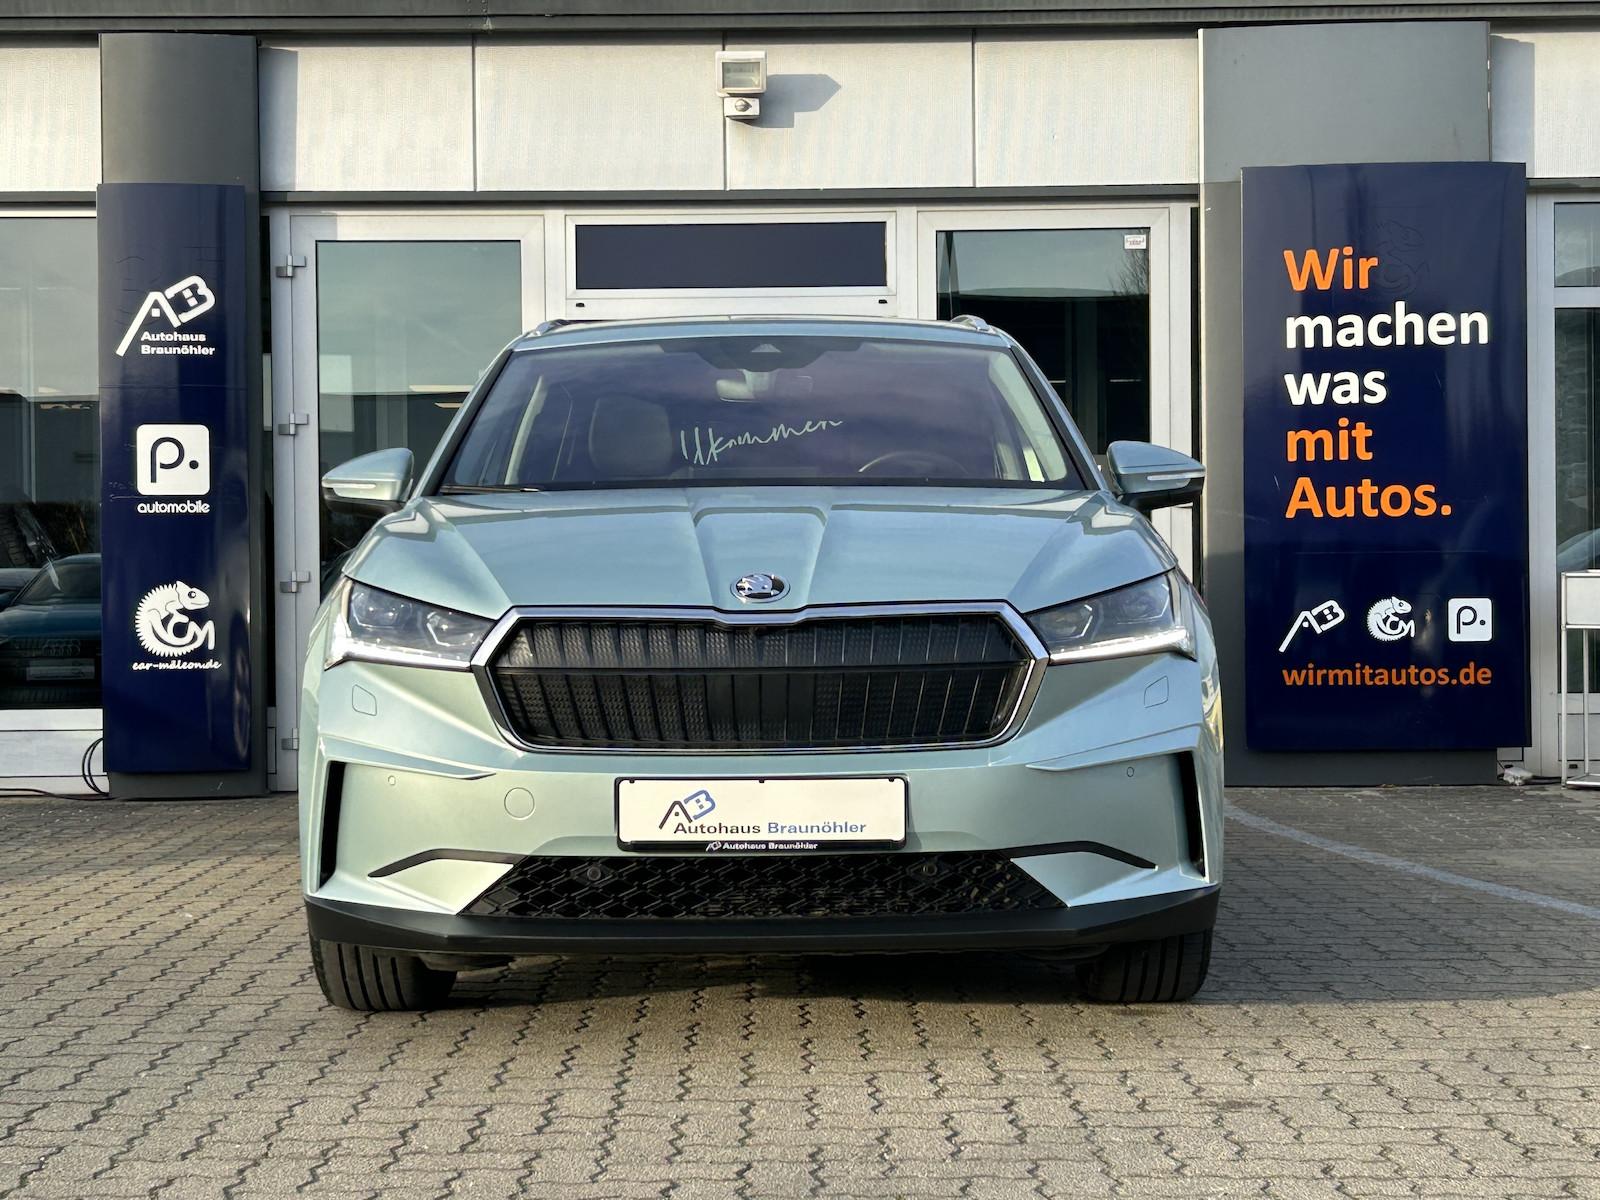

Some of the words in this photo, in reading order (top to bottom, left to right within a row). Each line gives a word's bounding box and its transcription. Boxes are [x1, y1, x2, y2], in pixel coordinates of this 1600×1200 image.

[1283, 246, 1378, 292] Wir
[140, 331, 207, 342] Autohaus
[1285, 300, 1489, 349] machen
[140, 344, 216, 356] Braunöhler
[1283, 370, 1387, 406] was
[1286, 417, 1374, 462] mit
[136, 500, 211, 514] automobile
[1285, 476, 1452, 519] Autos.
[1282, 662, 1492, 686] wirmitautos.de
[673, 822, 761, 835] Autohaus
[767, 821, 867, 835] Braunöhler
[722, 842, 767, 850] Autohaus
